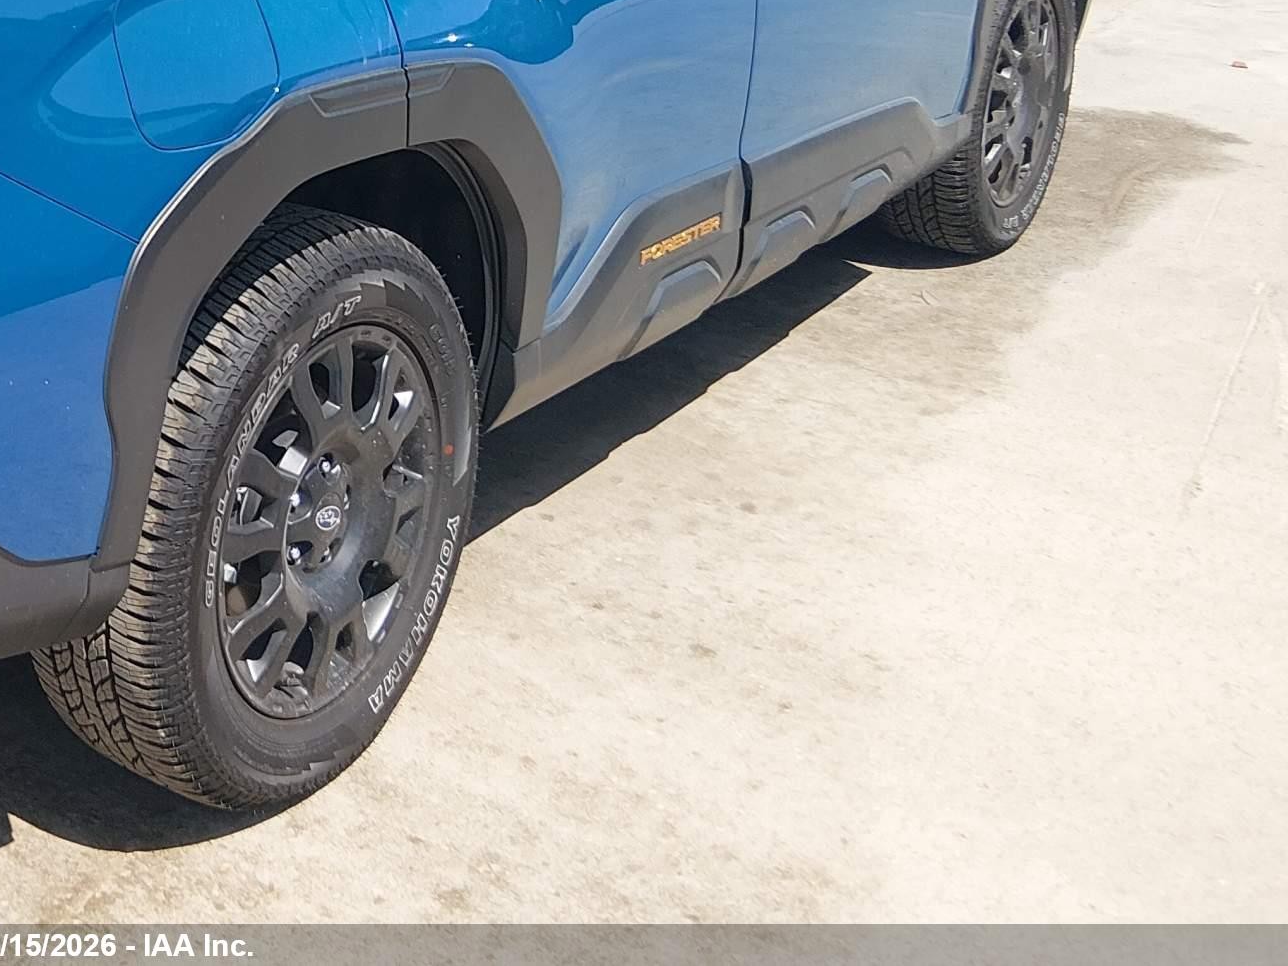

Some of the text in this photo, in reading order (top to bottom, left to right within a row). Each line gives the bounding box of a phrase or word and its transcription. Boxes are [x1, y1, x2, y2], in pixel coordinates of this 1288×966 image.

[640, 215, 721, 266] FORESTER
[204, 295, 362, 608] GEOLANDAR A/T
[367, 514, 462, 715] YOKOHAMA
